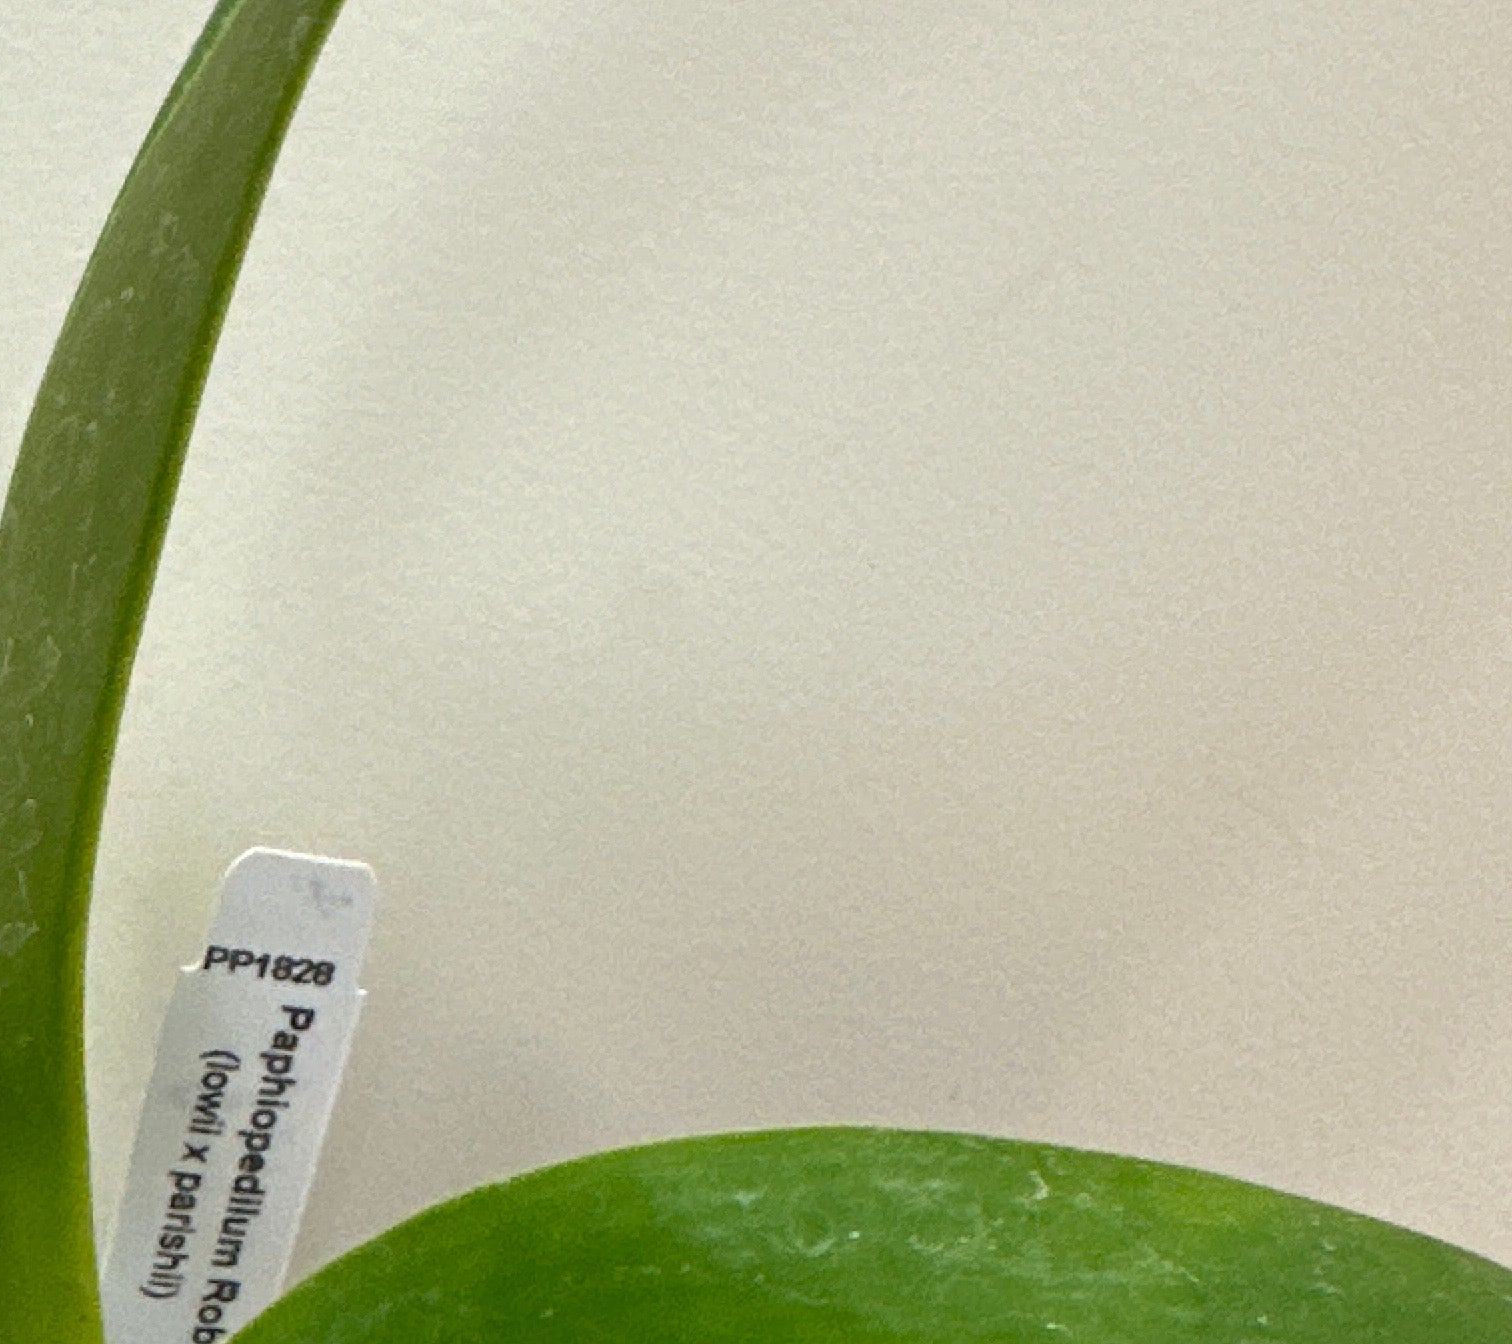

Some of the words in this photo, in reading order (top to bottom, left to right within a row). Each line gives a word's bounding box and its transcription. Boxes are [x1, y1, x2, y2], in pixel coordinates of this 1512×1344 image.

[202, 944, 336, 986] PP1828
[188, 1049, 241, 1136] (lowii
[211, 1004, 316, 1268] Paphiopedilum
[182, 1141, 210, 1163] x
[139, 1170, 201, 1298] parishii)
